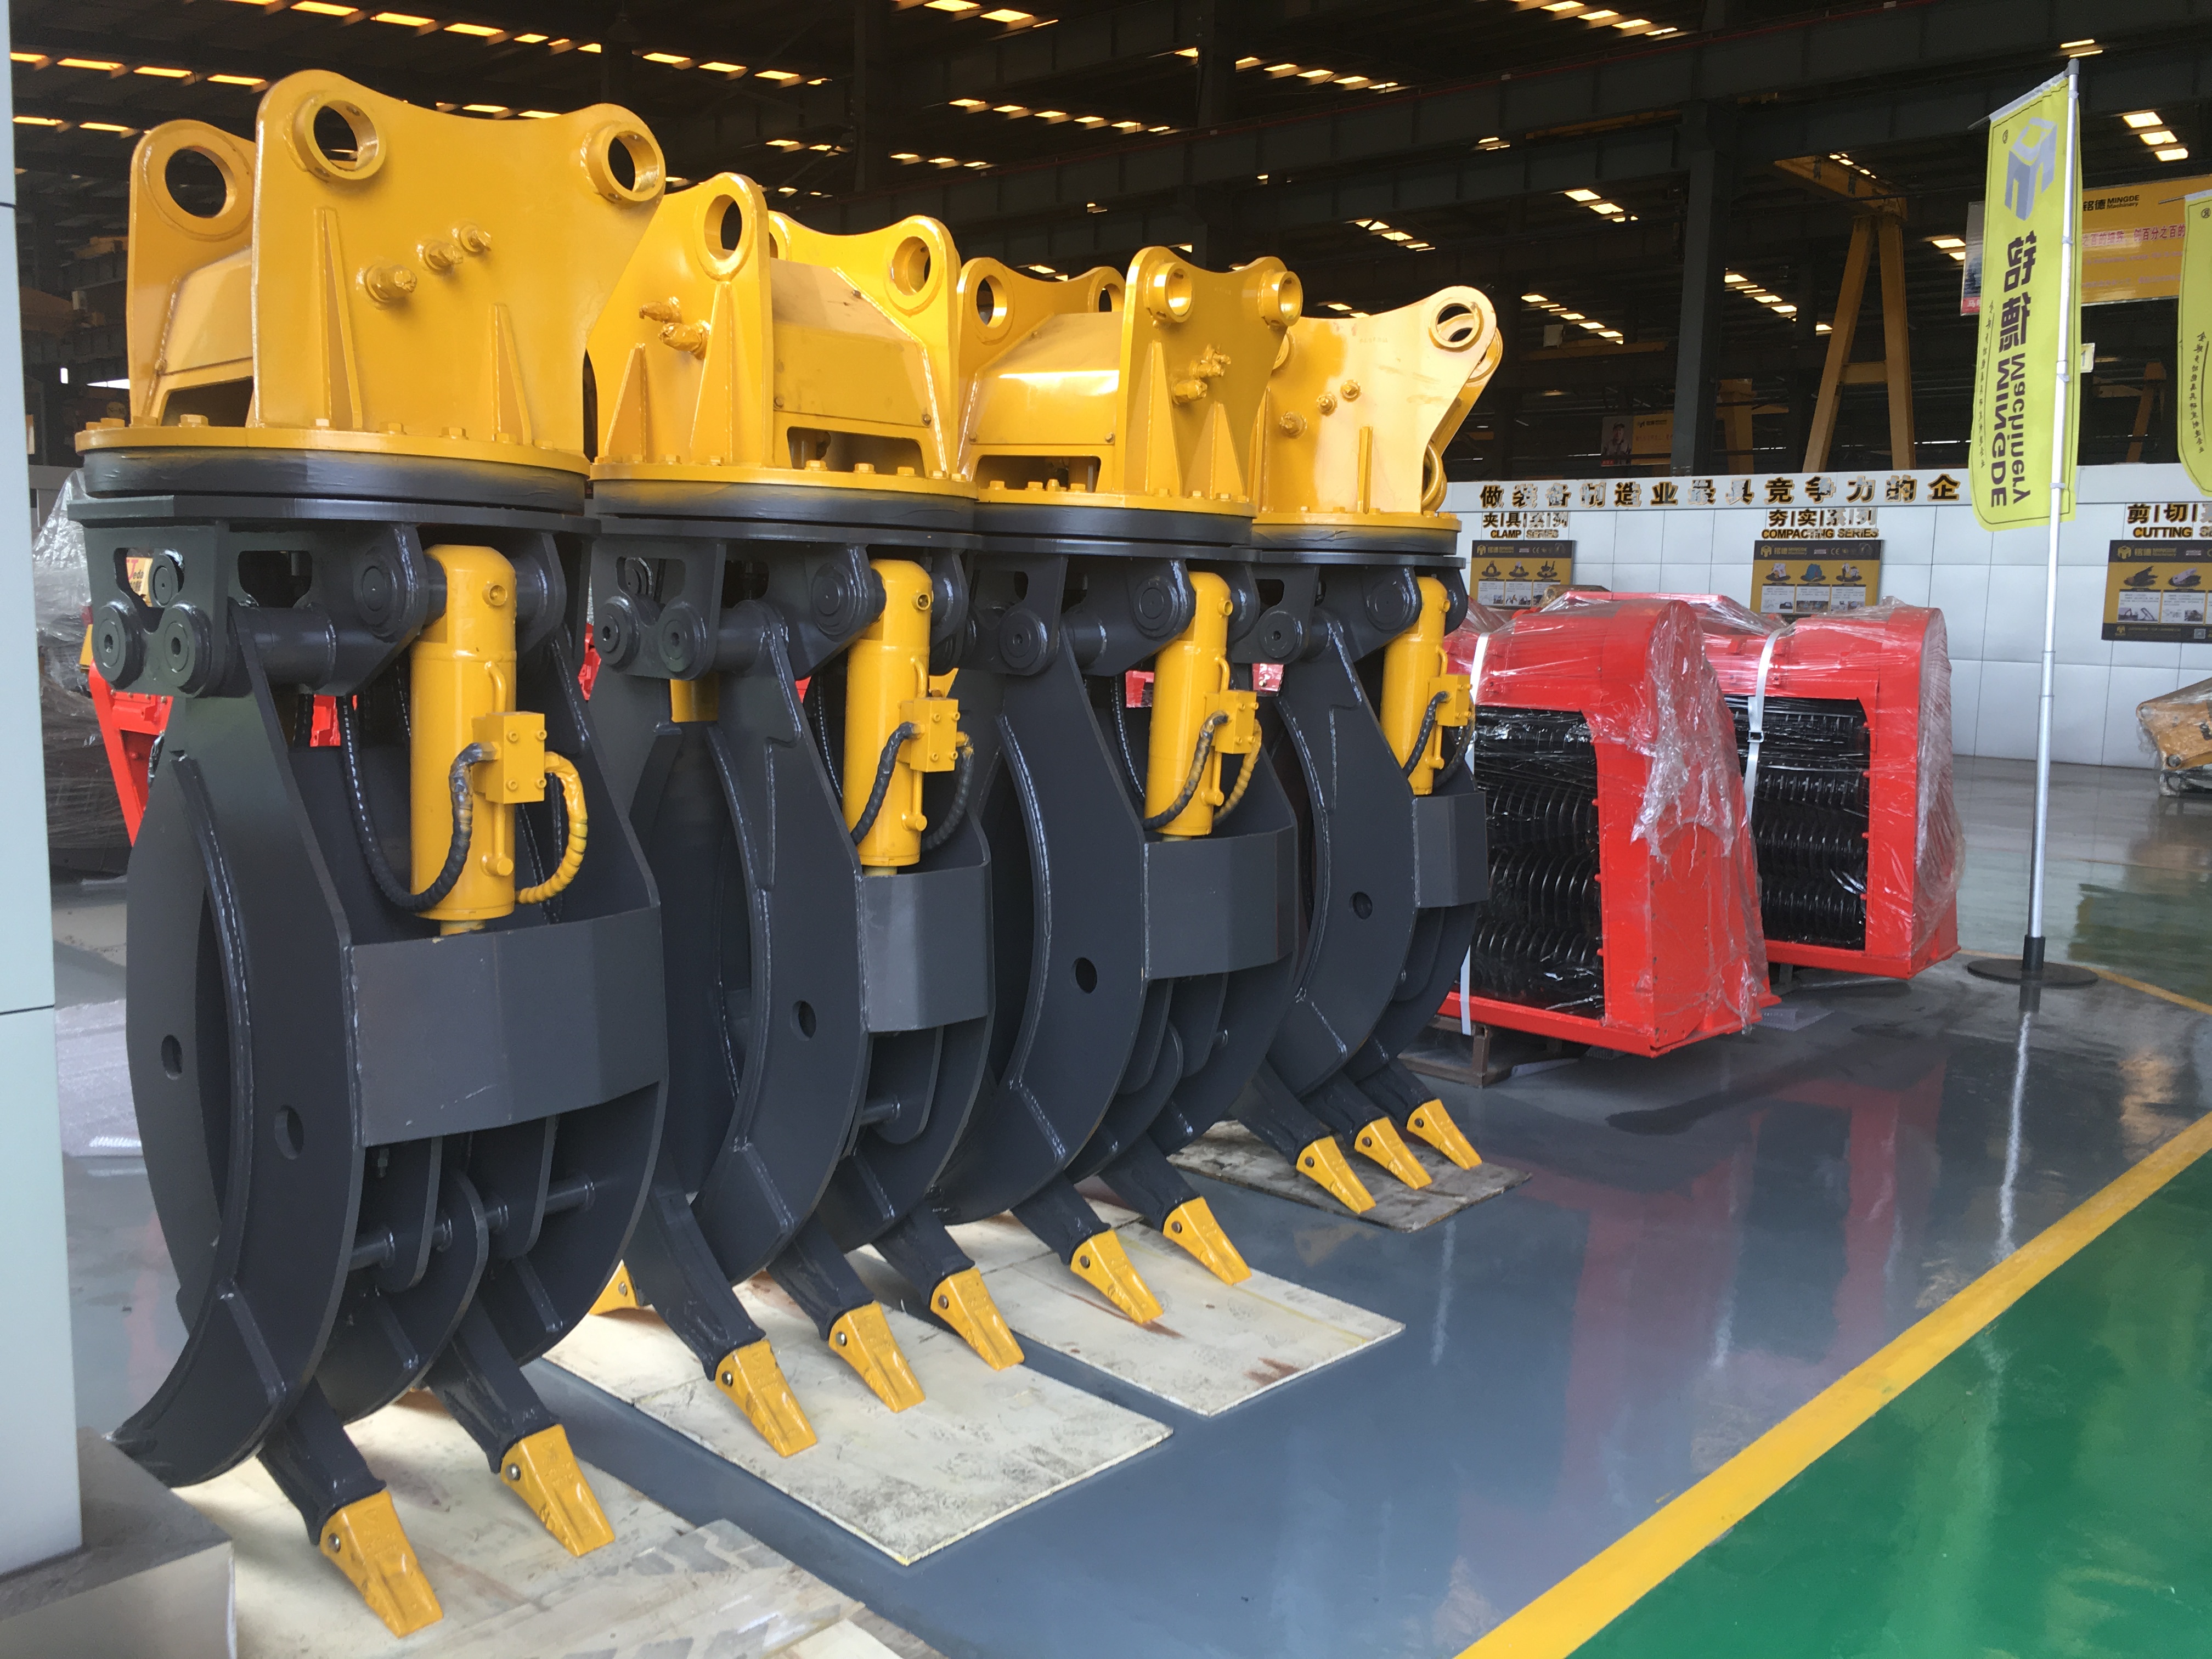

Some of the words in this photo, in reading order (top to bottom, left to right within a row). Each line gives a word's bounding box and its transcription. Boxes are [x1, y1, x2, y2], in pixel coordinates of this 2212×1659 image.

[2107, 195, 2140, 204] MINGDE
[1490, 529, 1522, 539] CLAMP
[1762, 528, 1835, 539] COMPACTING
[1837, 528, 1879, 539] SERIES
[2133, 527, 2193, 538] CUTTING
